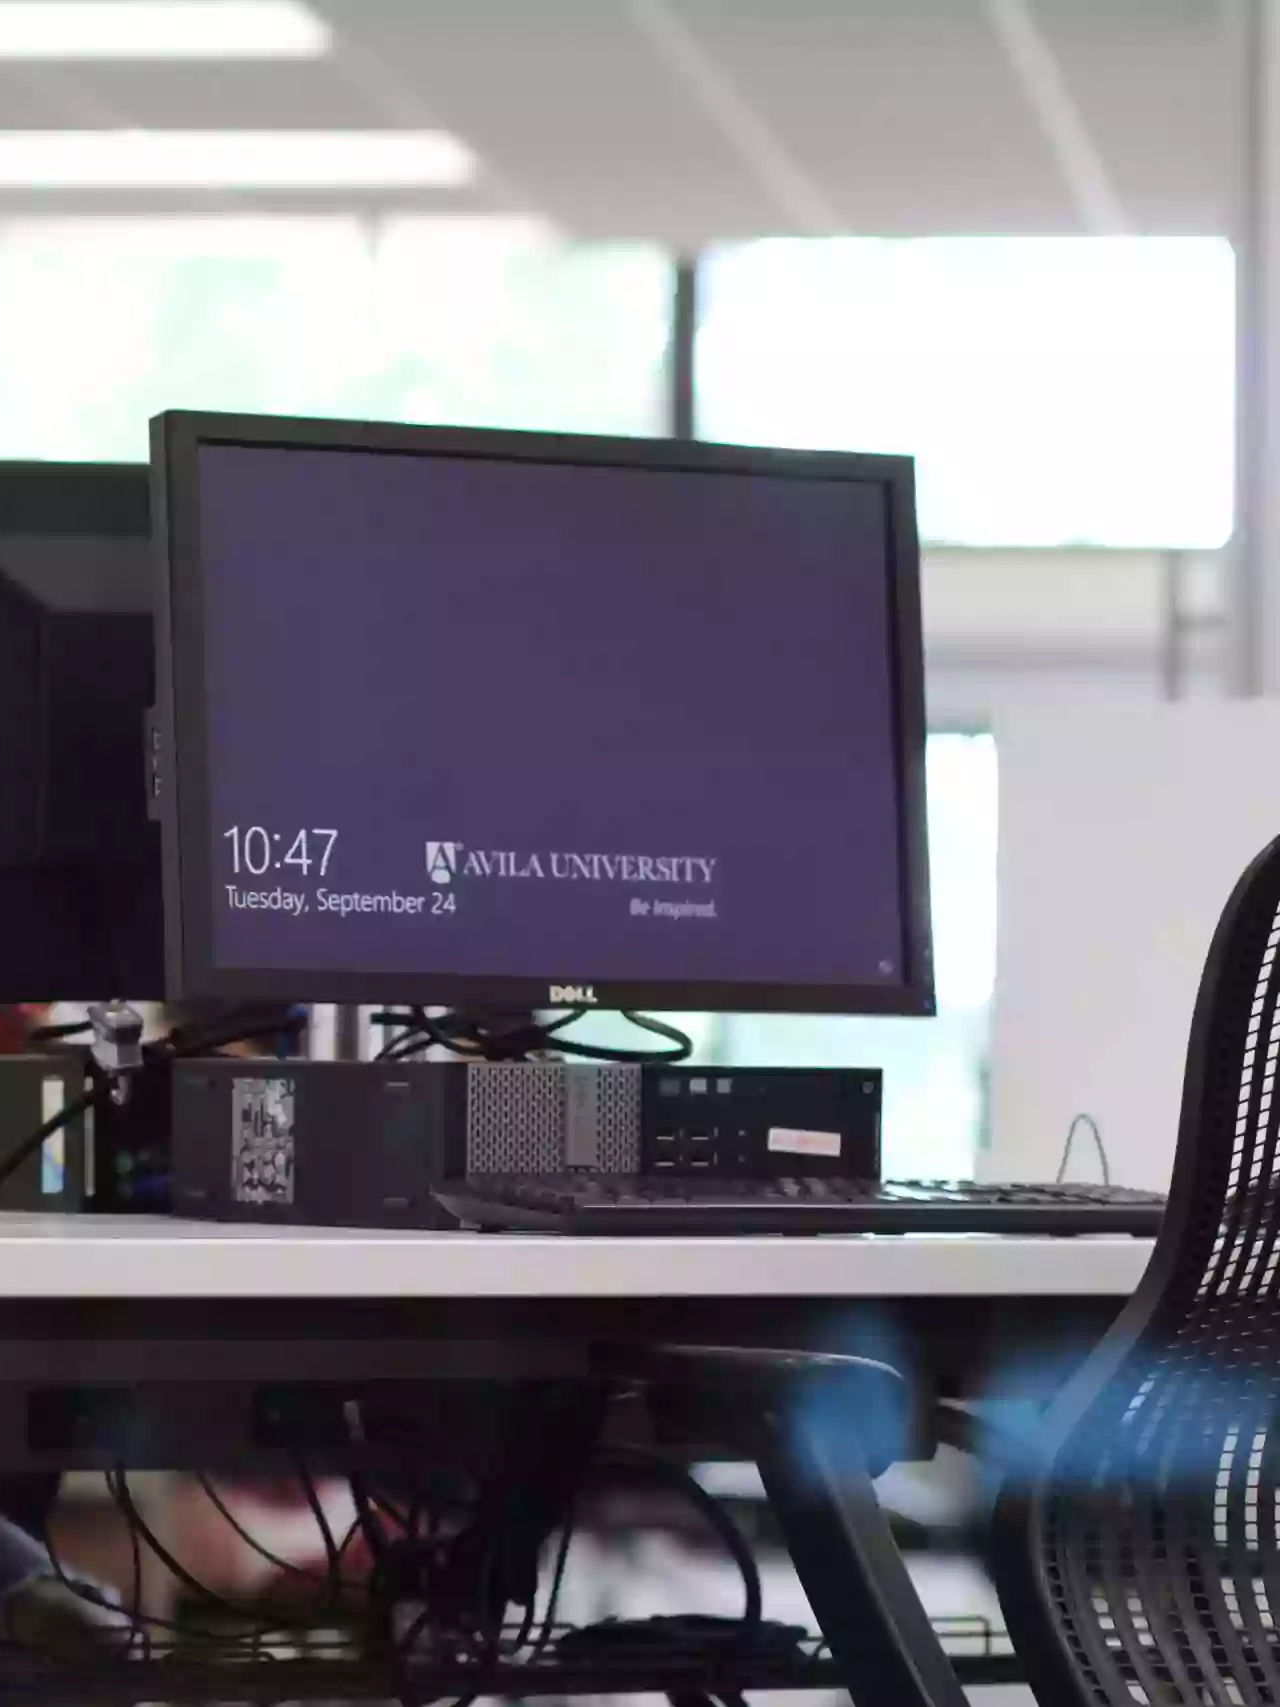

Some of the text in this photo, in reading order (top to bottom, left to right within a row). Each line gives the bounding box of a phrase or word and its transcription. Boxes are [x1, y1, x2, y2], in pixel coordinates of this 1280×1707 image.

[223, 825, 339, 876] 10:47
[463, 850, 717, 883] AVILA UNIVERSITY
[225, 885, 457, 917] Tuesday, September 24
[549, 985, 598, 1003] DELL
